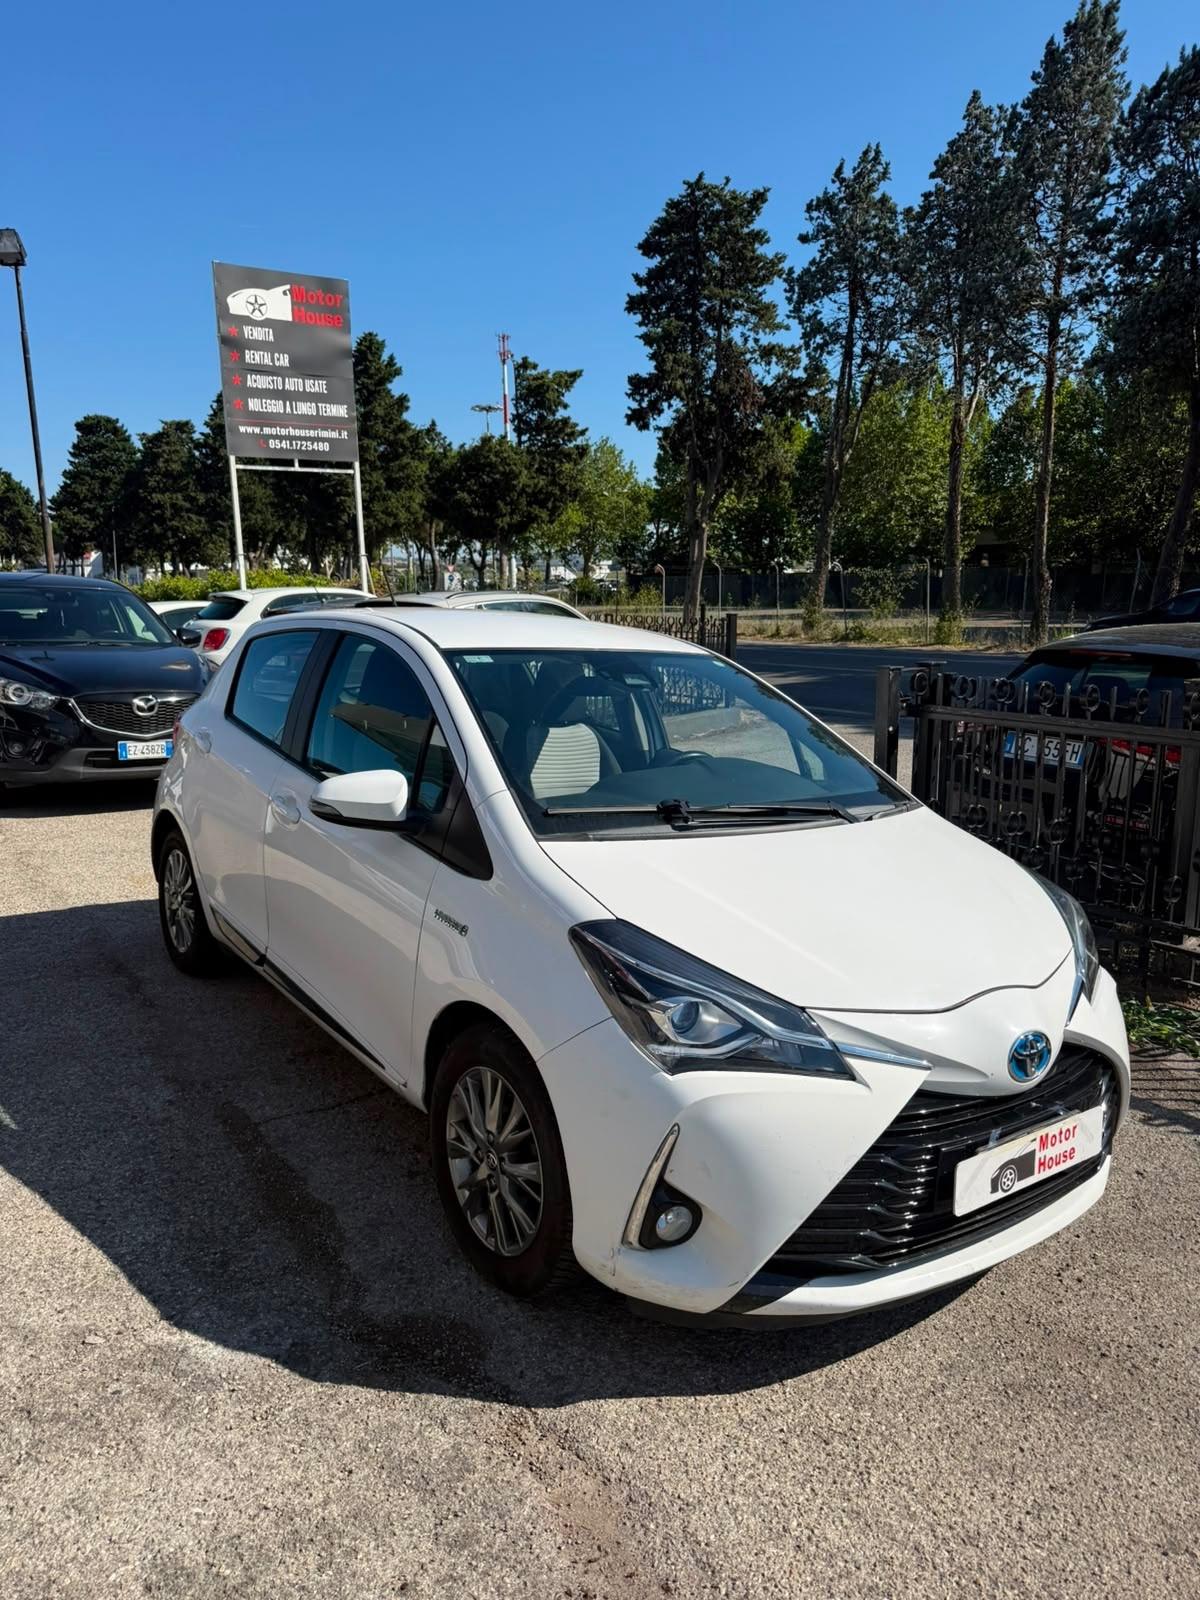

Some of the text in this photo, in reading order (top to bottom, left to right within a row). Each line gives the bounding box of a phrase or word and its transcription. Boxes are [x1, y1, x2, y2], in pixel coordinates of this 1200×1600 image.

[292, 285, 344, 308] Motor
[293, 306, 344, 328] House
[243, 325, 274, 343] VENDITA
[245, 350, 290, 368] RENTAL CAR
[247, 374, 328, 394] ACQUISTO AUTO USATE
[248, 398, 349, 418] NOLEGGIO A LUNGO TERMINE
[239, 425, 349, 440] www.motorhouserimini.it
[269, 440, 330, 452] 0541.1725480
[1039, 1125, 1078, 1153] Motor
[1037, 1146, 1076, 1174] House
